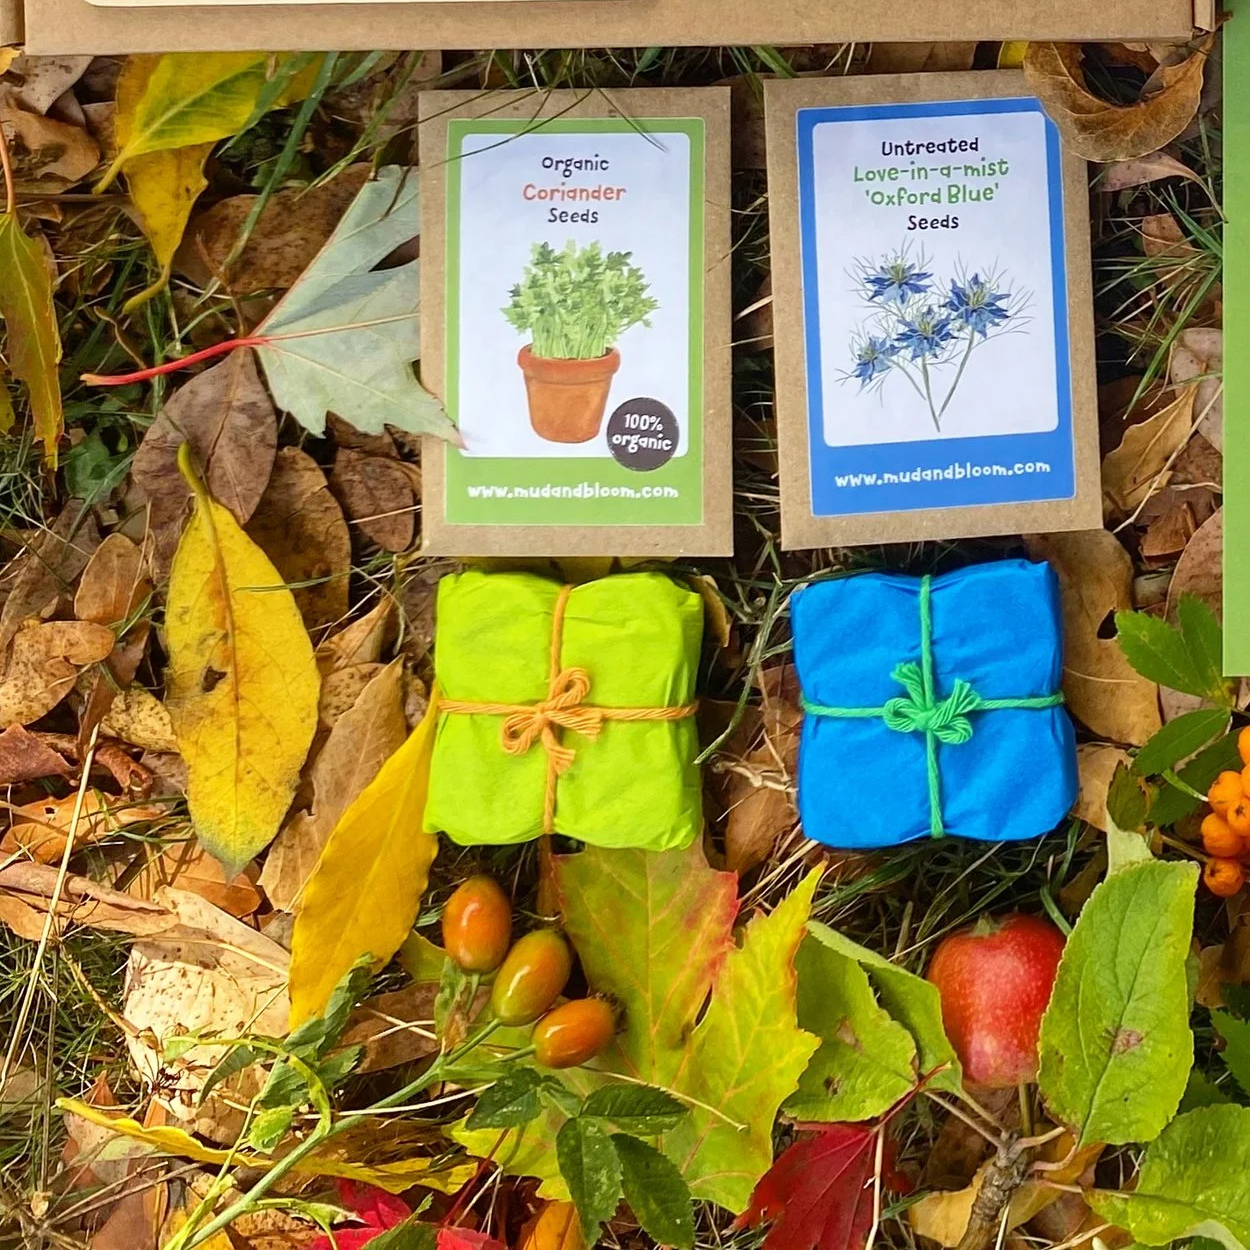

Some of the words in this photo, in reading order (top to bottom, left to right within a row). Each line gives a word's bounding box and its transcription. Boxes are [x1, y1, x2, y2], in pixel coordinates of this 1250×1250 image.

[881, 137, 979, 157] Untreated
[541, 153, 610, 177] Organic
[853, 156, 1010, 183] Love-in-a-mist
[522, 181, 627, 202] Coriander
[865, 186, 942, 207] 'Oxford
[947, 182, 999, 204] Blue'
[547, 207, 599, 224] Seeds
[907, 214, 959, 231] Seeds
[624, 413, 664, 434] 100%
[610, 433, 676, 455] organic
[834, 461, 1051, 488] www.mudandbloom.com
[467, 479, 679, 499] www.mudandbloom.com
